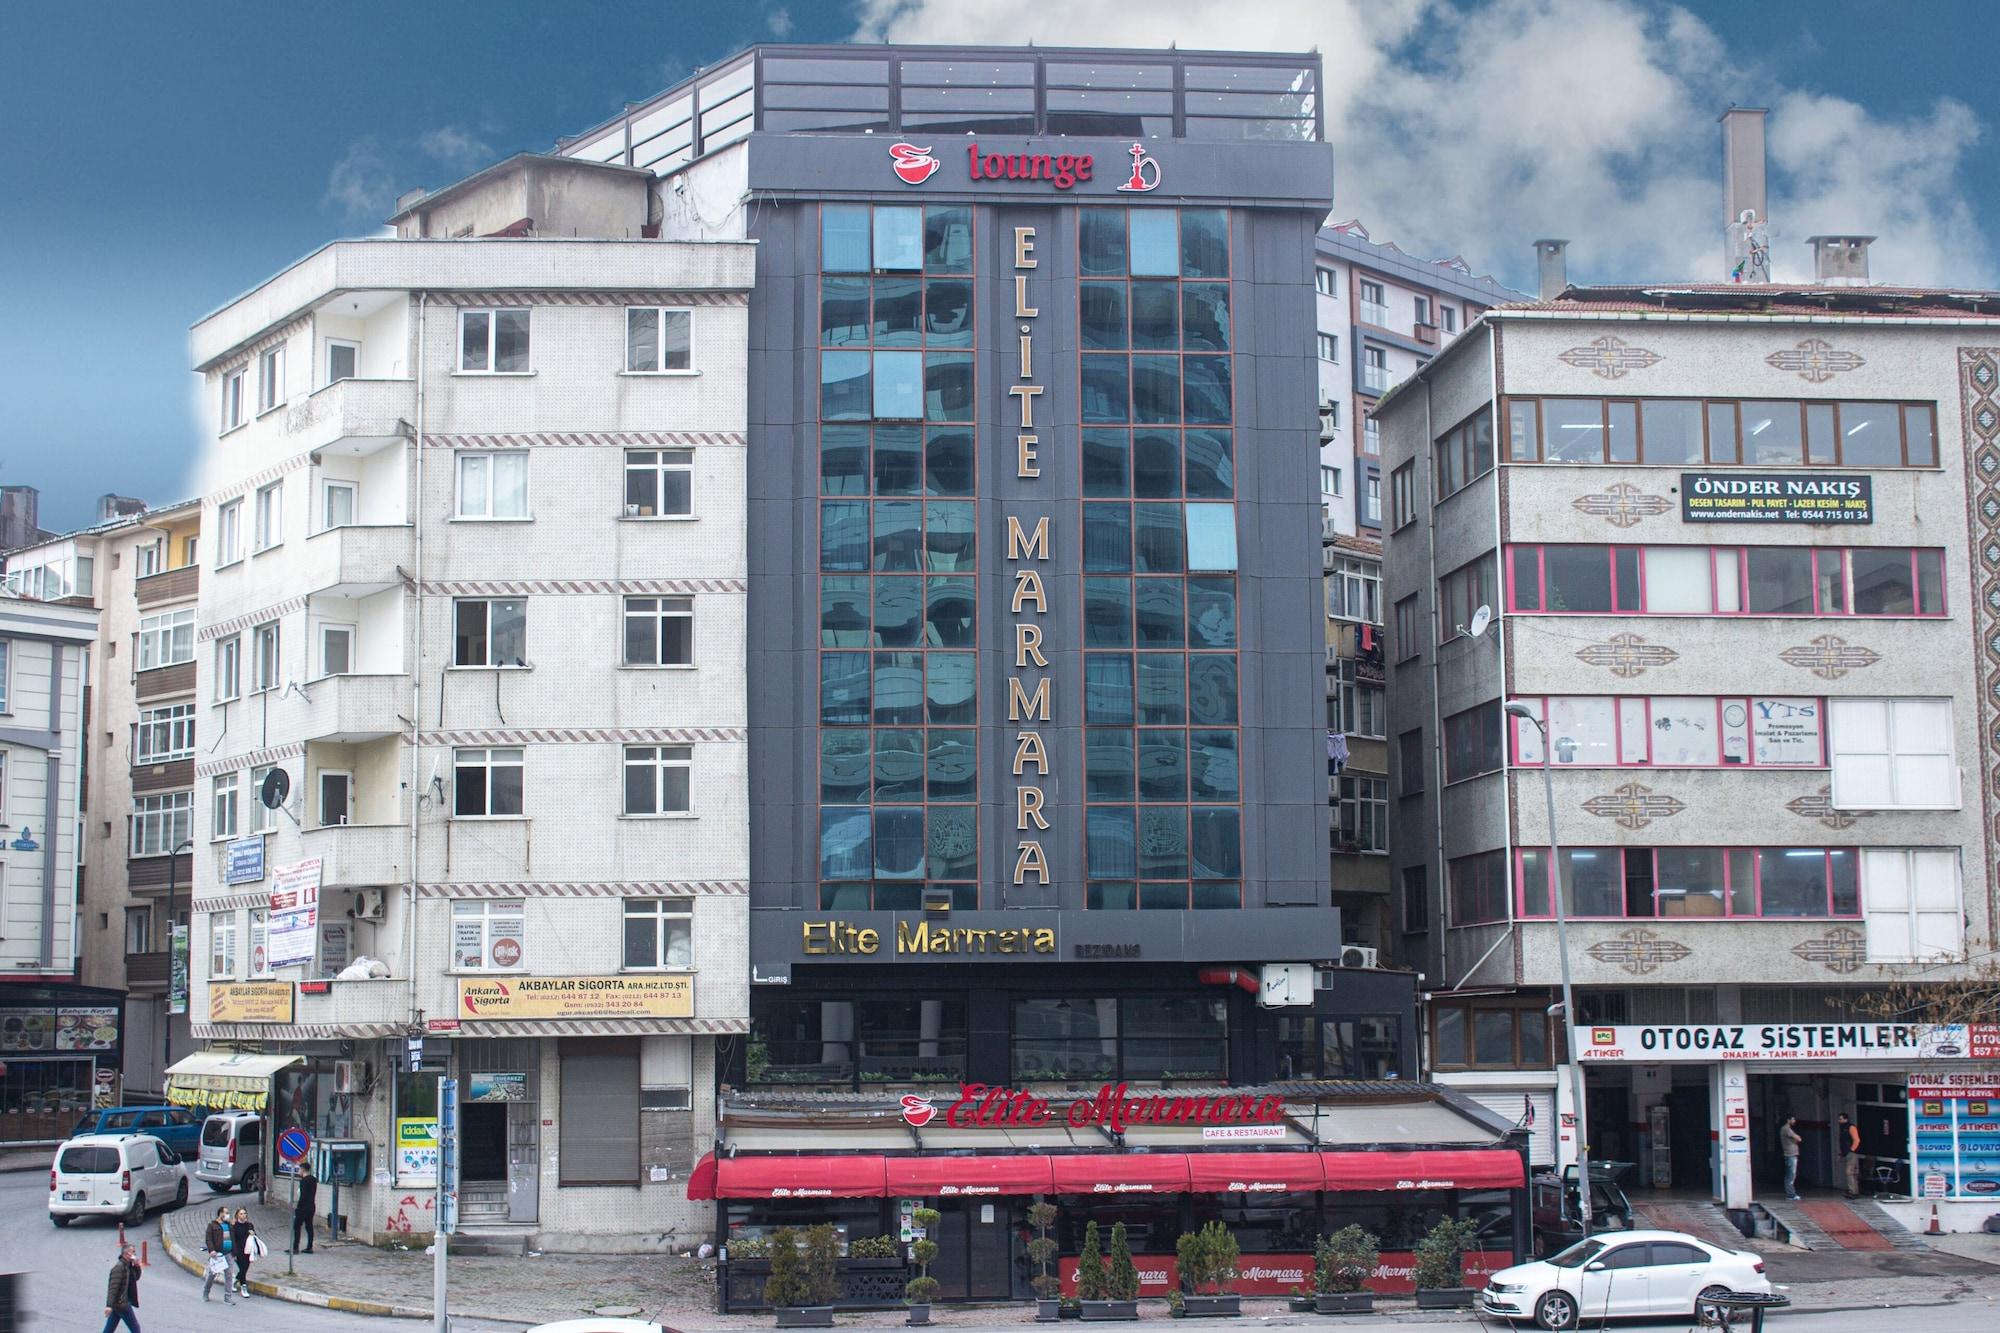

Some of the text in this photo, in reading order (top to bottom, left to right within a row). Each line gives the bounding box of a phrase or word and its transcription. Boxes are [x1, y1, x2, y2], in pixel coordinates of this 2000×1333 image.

[967, 143, 1094, 189] lounge
[1694, 478, 1861, 498] ÖNDER NAKIŞ
[1689, 498, 1713, 508] DESEN
[1714, 498, 1746, 508] TASARIM
[1751, 499, 1766, 508] PUL
[1766, 499, 1788, 508] PAYET
[1794, 499, 1816, 509] LAZER
[1785, 510, 1800, 519] Tel:
[1802, 511, 1824, 519] 0544
[1826, 511, 1842, 519] 715
[1844, 512, 1855, 520] 01
[1857, 512, 1868, 520] 34
[1006, 516, 1052, 885] MARMARA
[1755, 701, 1815, 720] YTS
[803, 921, 1056, 954] Elite Marmara
[465, 987, 500, 995] Ankara
[518, 981, 575, 990] AKBAYLAR
[474, 997, 510, 1006] Sigorta
[1641, 1028, 1744, 1049] OTOGAZ
[1973, 1047, 1991, 1055] 557
[947, 1082, 1285, 1133] Elite Marmara
[1234, 1128, 1284, 1136] RESTAURANT
[1242, 1267, 1304, 1280] Marmara
